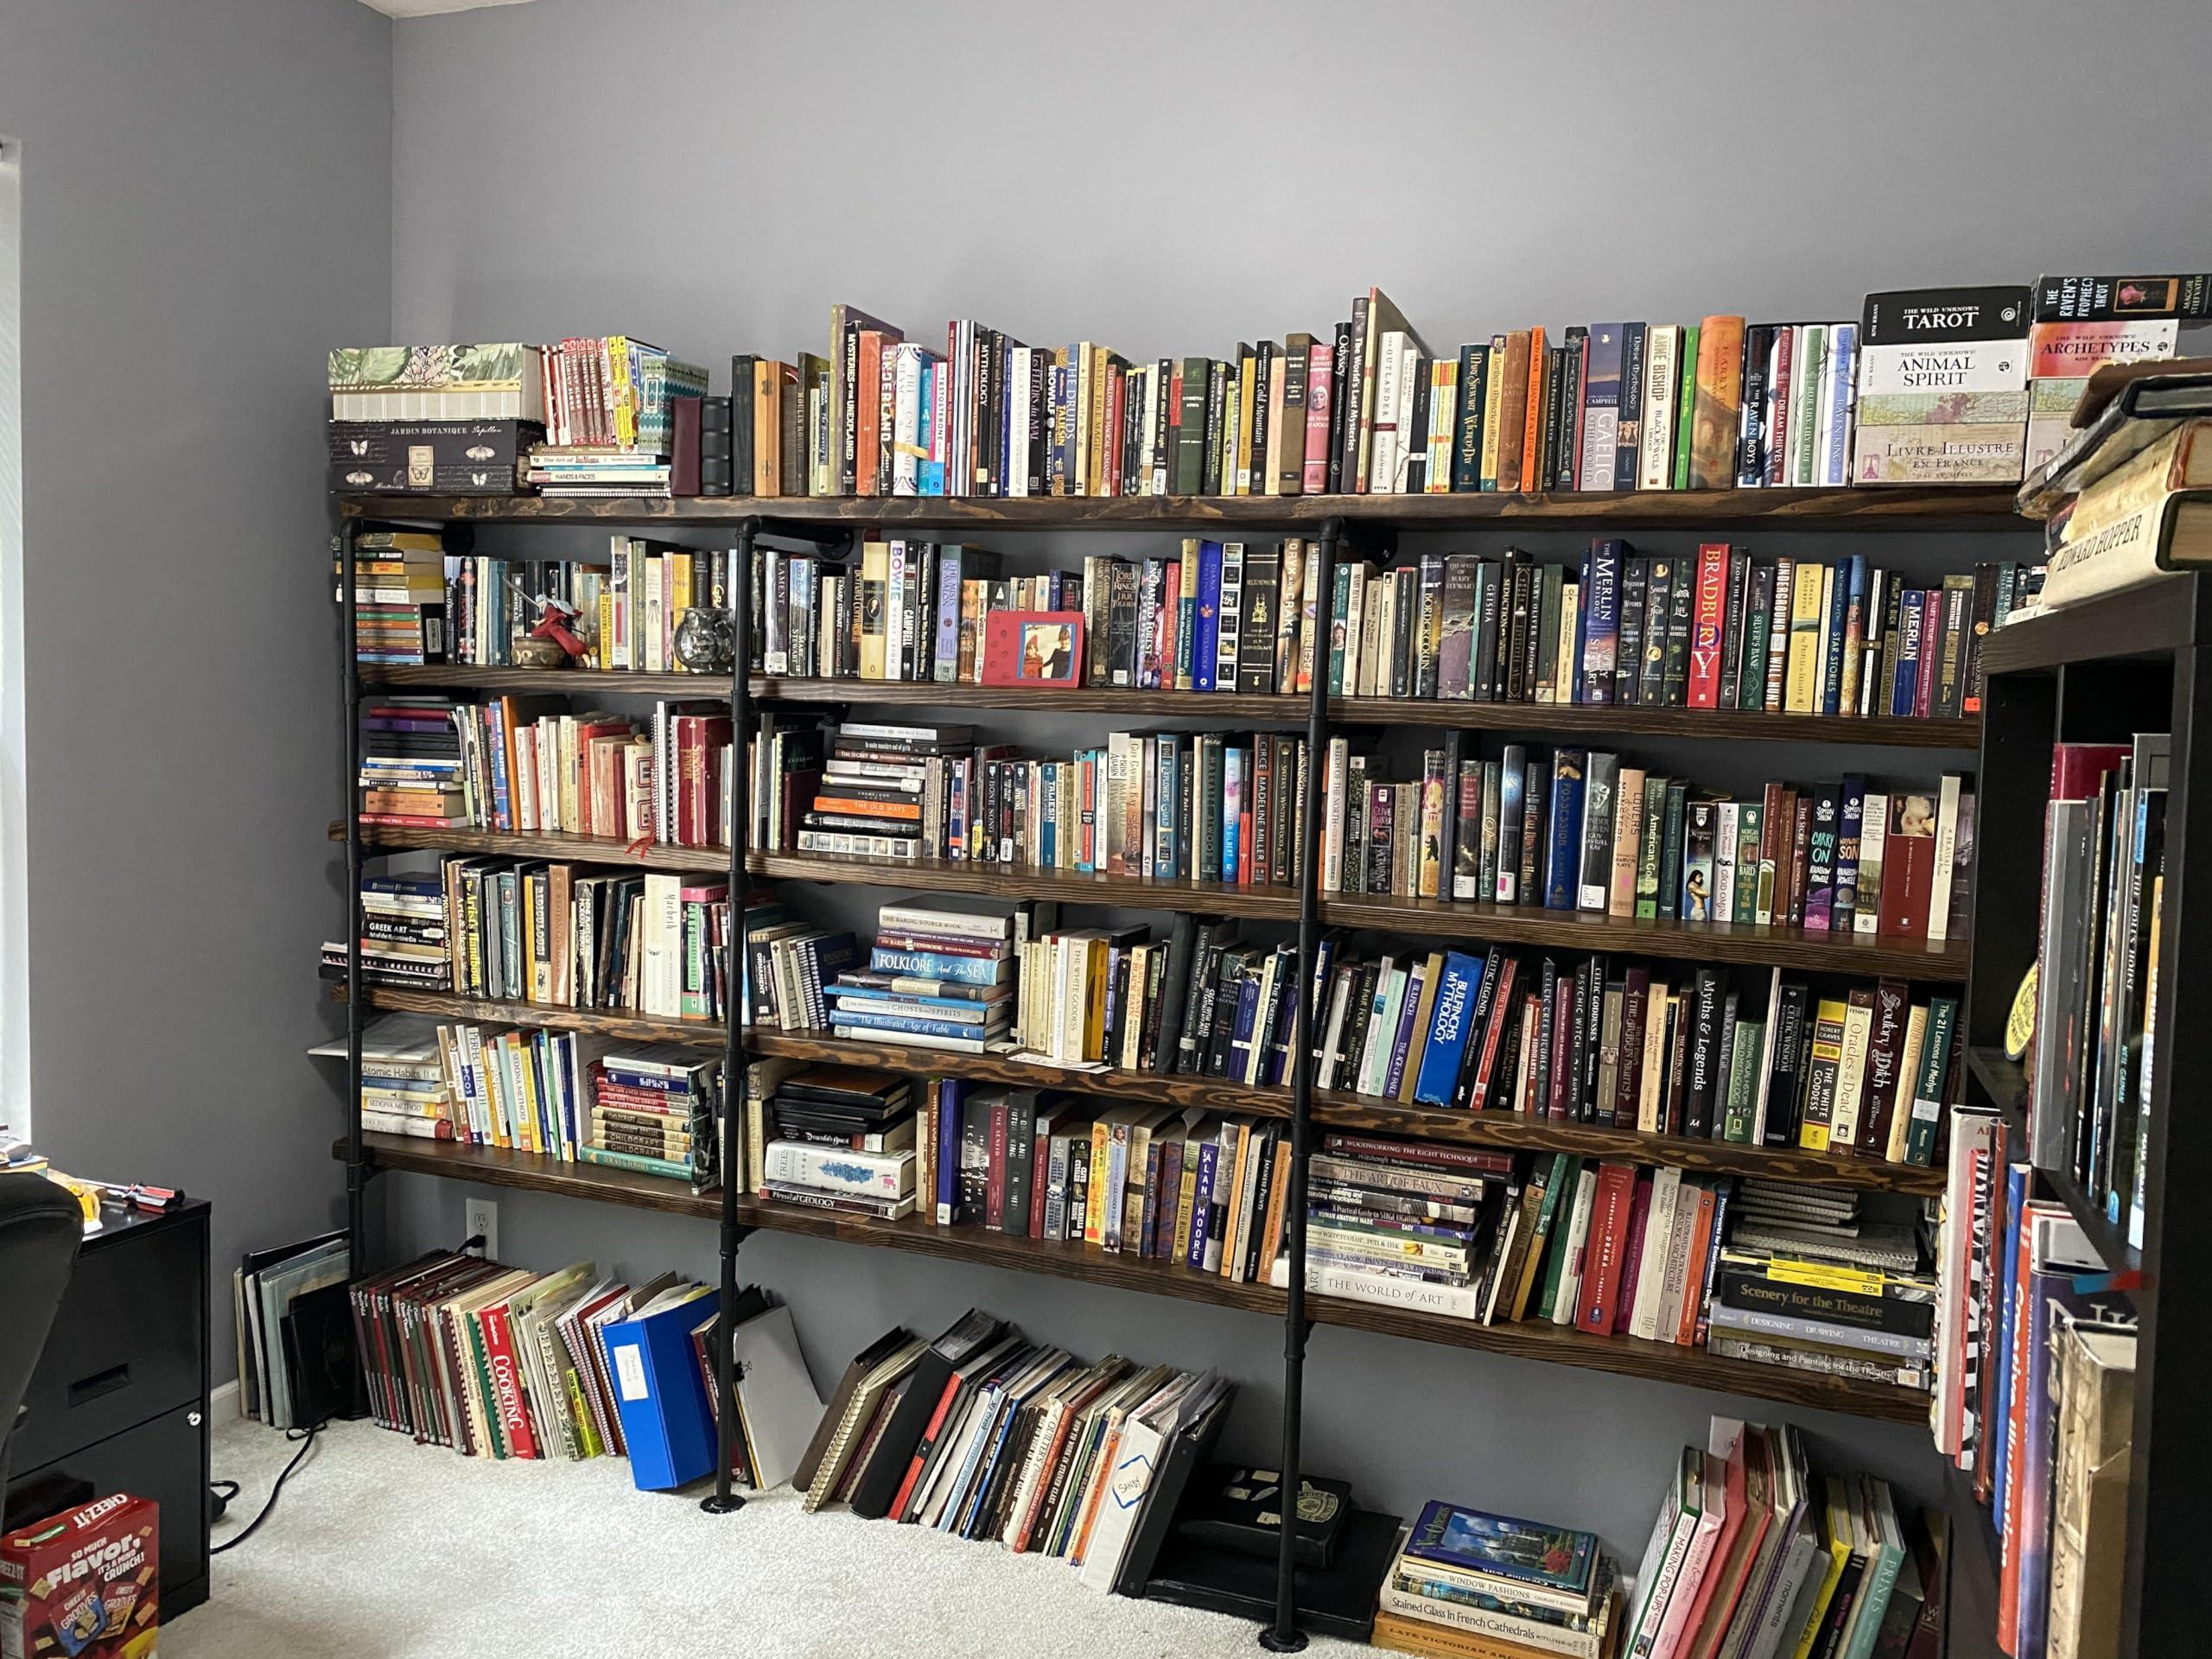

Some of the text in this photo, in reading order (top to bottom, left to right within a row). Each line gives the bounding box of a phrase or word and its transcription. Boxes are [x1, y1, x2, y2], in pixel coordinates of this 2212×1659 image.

[2046, 289, 2059, 305] THE
[2059, 277, 2077, 318] RAVEN'S
[2077, 277, 2094, 317] PROPHECY
[2094, 283, 2109, 308] TAROT
[2183, 278, 2193, 311] MAGGIE
[1903, 313, 1979, 329] TAROT
[1355, 338, 1363, 352] The
[2040, 340, 2150, 354] ARCHETYPES
[1382, 349, 1393, 416] OUTLANDER
[1897, 357, 1976, 372] ANIMAL
[1903, 372, 1967, 387] SPIRIT
[846, 334, 856, 461] MYSTERIES UNEXPLAINED
[1047, 365, 1057, 416] BEOWULF
[1066, 361, 1077, 440] THE DRUIDS
[391, 427, 419, 435] JARDIN
[1055, 405, 1065, 446] TALIESIN
[1348, 410, 1358, 452] Mysteries
[1751, 401, 1759, 435] RAVEN
[1584, 415, 1596, 482] OTHERWORLD
[1593, 413, 1615, 485] GAELIC
[1745, 440, 1756, 466] BOYS
[1913, 458, 1984, 468] EN FRANCE
[2056, 515, 2143, 572] EDWARD HOPPER
[891, 547, 903, 601] BOWIE
[1283, 543, 1299, 634] ORYX CRAKE
[1597, 557, 1615, 620] MERLIN
[1484, 583, 1495, 623] GEISHA
[1500, 578, 1510, 627] SEDUCTION
[1700, 549, 1721, 651] BRADBURY
[903, 609, 914, 647] CAMPBELL
[1765, 563, 1791, 707] UNDERGROUND WILL HUNT
[1599, 647, 1611, 679] MARY
[1827, 631, 1841, 693] STAR STORIES
[1255, 741, 1268, 861] CIRCE MADELINE MILLER
[1645, 813, 1660, 889] American Gods
[1811, 831, 1834, 849] CARRY
[1812, 848, 1831, 863] ON
[1809, 865, 1832, 876] RAINBOW
[1810, 874, 1829, 884] ROWELL
[369, 923, 407, 933] GREEK ART
[664, 893, 677, 930] Macbeth
[688, 904, 696, 936] PLAYS
[919, 918, 943, 927] SOURCE
[756, 952, 766, 995] ORNAMENT
[879, 953, 931, 973] FOLKLORE
[967, 965, 987, 980] SEA
[860, 1016, 872, 1025] The
[874, 1017, 907, 1029] Illustrated
[908, 1020, 921, 1032] Age
[923, 1023, 930, 1032] of
[931, 1023, 950, 1034] Fable
[1434, 971, 1459, 1045] MYTHOLOGY
[1590, 995, 1599, 1041] GODDESSES
[1694, 980, 1715, 1091] Myths & Legends
[462, 1068, 472, 1096] PCOS
[1839, 1023, 1862, 1115] Oracles Dead
[2118, 1070, 2126, 1103] GAIMAN
[1809, 1071, 1822, 1111] GODDESS
[1819, 1067, 1834, 1118] THE WHITE
[610, 1134, 659, 1147] CHILDCRAFT
[1417, 1149, 1438, 1158] RIGHT
[1440, 1153, 1478, 1163] TECHNIQUE
[779, 1149, 789, 1177] TREES
[1342, 1168, 1443, 1193] THE ART OF FAUX
[799, 1196, 836, 1208] GEOLOGY
[1192, 1151, 1212, 1261] ALAN MOORE
[1326, 1278, 1443, 1306] THE WORLD of ART
[1740, 1284, 1884, 1319] Scenery for the Theatre
[1751, 1317, 1901, 1349] DESIGNING DRAWING THEATRE
[493, 1355, 524, 1430] COOKING
[47, 1534, 141, 1590] Flavor,
[71, 1537, 107, 1560] SO MUCH
[104, 1552, 145, 1582] CRUNCH!
[1448, 1574, 1530, 1599] WINDOW FASHIONS
[1650, 1536, 1685, 1613] MAKING POP-UPS
[1872, 1558, 1896, 1614] PRINTS
[1391, 1598, 1535, 1639] Stained Glass in French Cathedrals
[1770, 1580, 1794, 1628] moments
